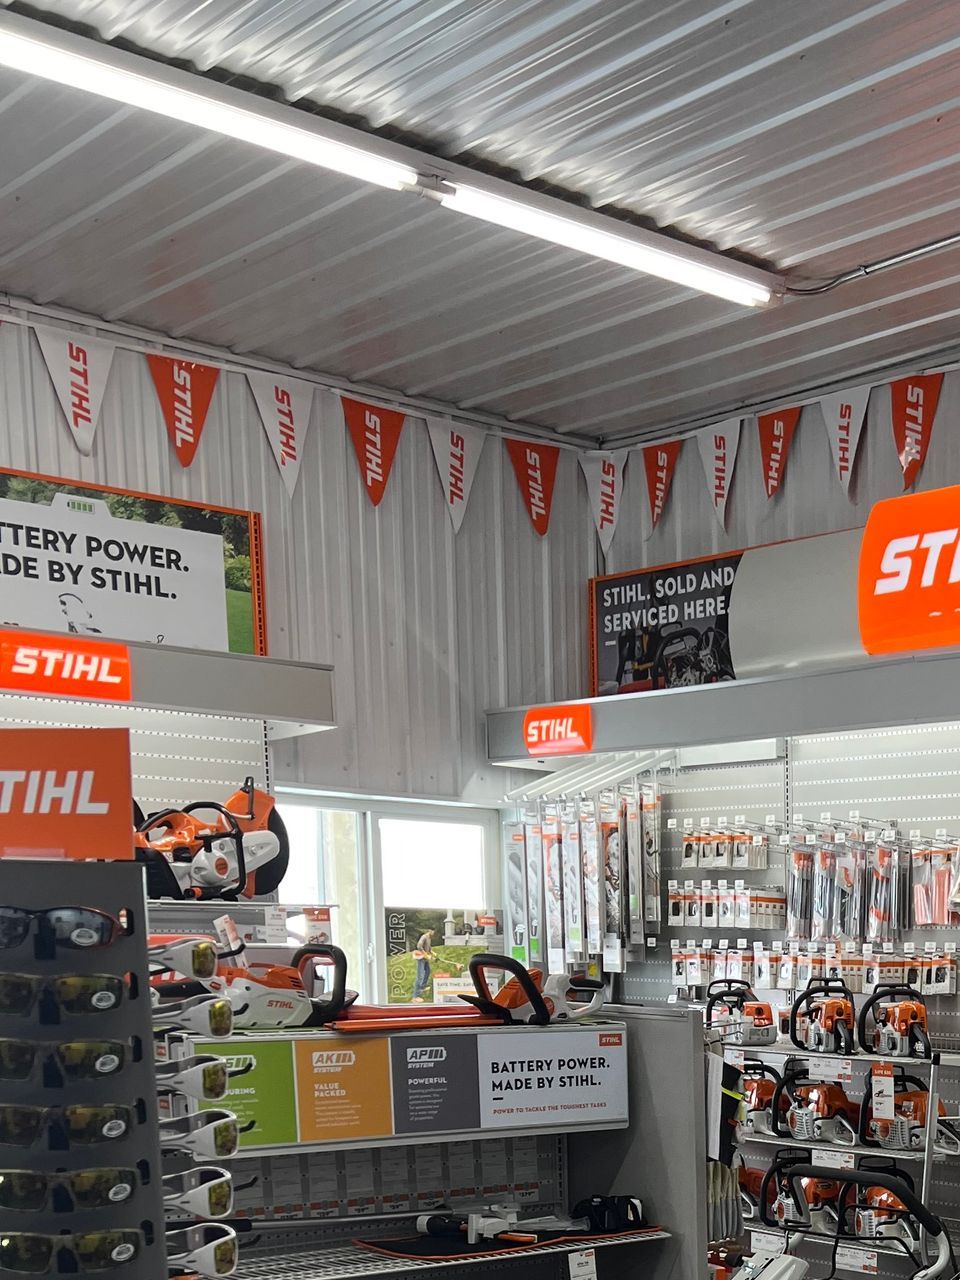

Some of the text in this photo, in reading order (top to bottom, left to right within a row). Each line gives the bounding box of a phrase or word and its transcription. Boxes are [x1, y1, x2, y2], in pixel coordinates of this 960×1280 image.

[67, 341, 91, 428] STIHL
[172, 358, 194, 447] STIHL
[274, 385, 298, 467] STIHL
[838, 403, 852, 481] STIHL
[906, 384, 925, 461] STIHL
[365, 410, 384, 486] STIHL
[450, 430, 465, 504] STIHL
[713, 435, 726, 507] STIHL
[767, 420, 784, 495] STIHL
[526, 448, 543, 520] STIHL
[600, 458, 615, 529] STIHL
[654, 451, 668, 523] STIHL
[0, 553, 177, 600] DE BY STIHL.
[85, 535, 190, 572] POWER.
[603, 566, 735, 608] STIHL. SOLD AND
[604, 604, 679, 633] SERVICED
[11, 646, 122, 684] STIHL
[527, 716, 579, 743] STIHL
[389, 913, 406, 998] POWER
[266, 1000, 294, 1009] STIHL
[315, 1053, 335, 1065] AK
[409, 1050, 428, 1060] AP
[491, 1057, 611, 1074] BATTERY POWER.
[314, 1082, 339, 1090] VALUE
[314, 1089, 346, 1098] PACKED
[408, 1077, 447, 1085] POWERFUL
[492, 1075, 602, 1092] MADE BY STIHL.
